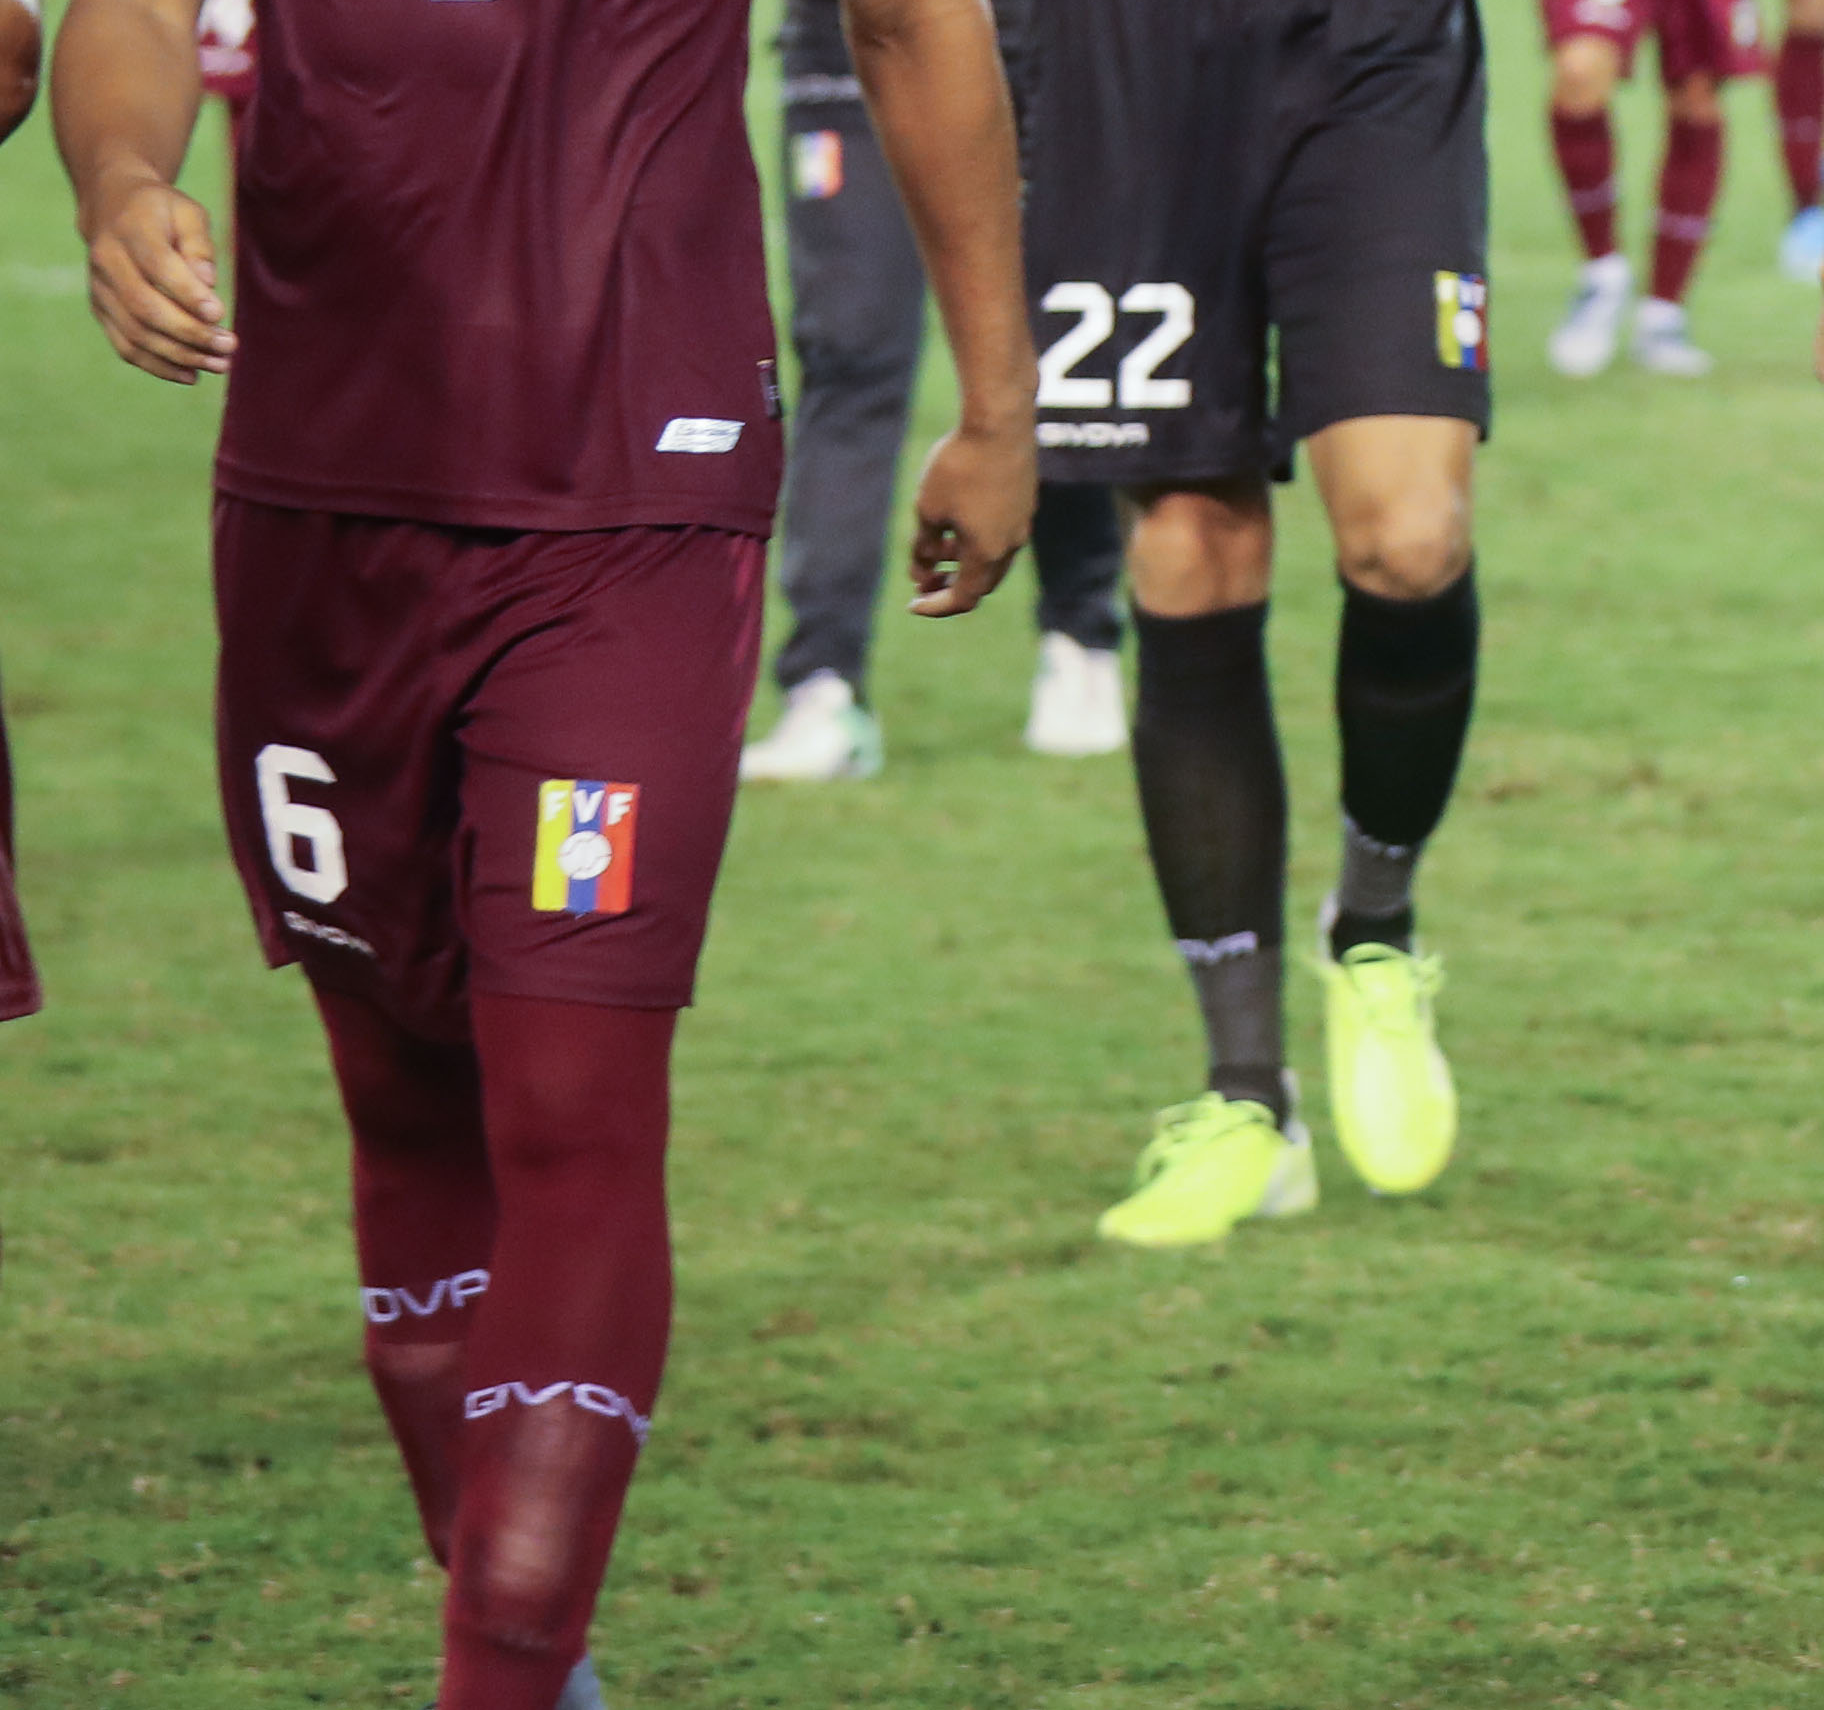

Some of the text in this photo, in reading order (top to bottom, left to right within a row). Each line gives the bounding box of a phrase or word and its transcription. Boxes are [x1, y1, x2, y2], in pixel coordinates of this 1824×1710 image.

[1036, 282, 1195, 409] 22
[254, 743, 349, 905] 6
[543, 788, 635, 827] FVF
